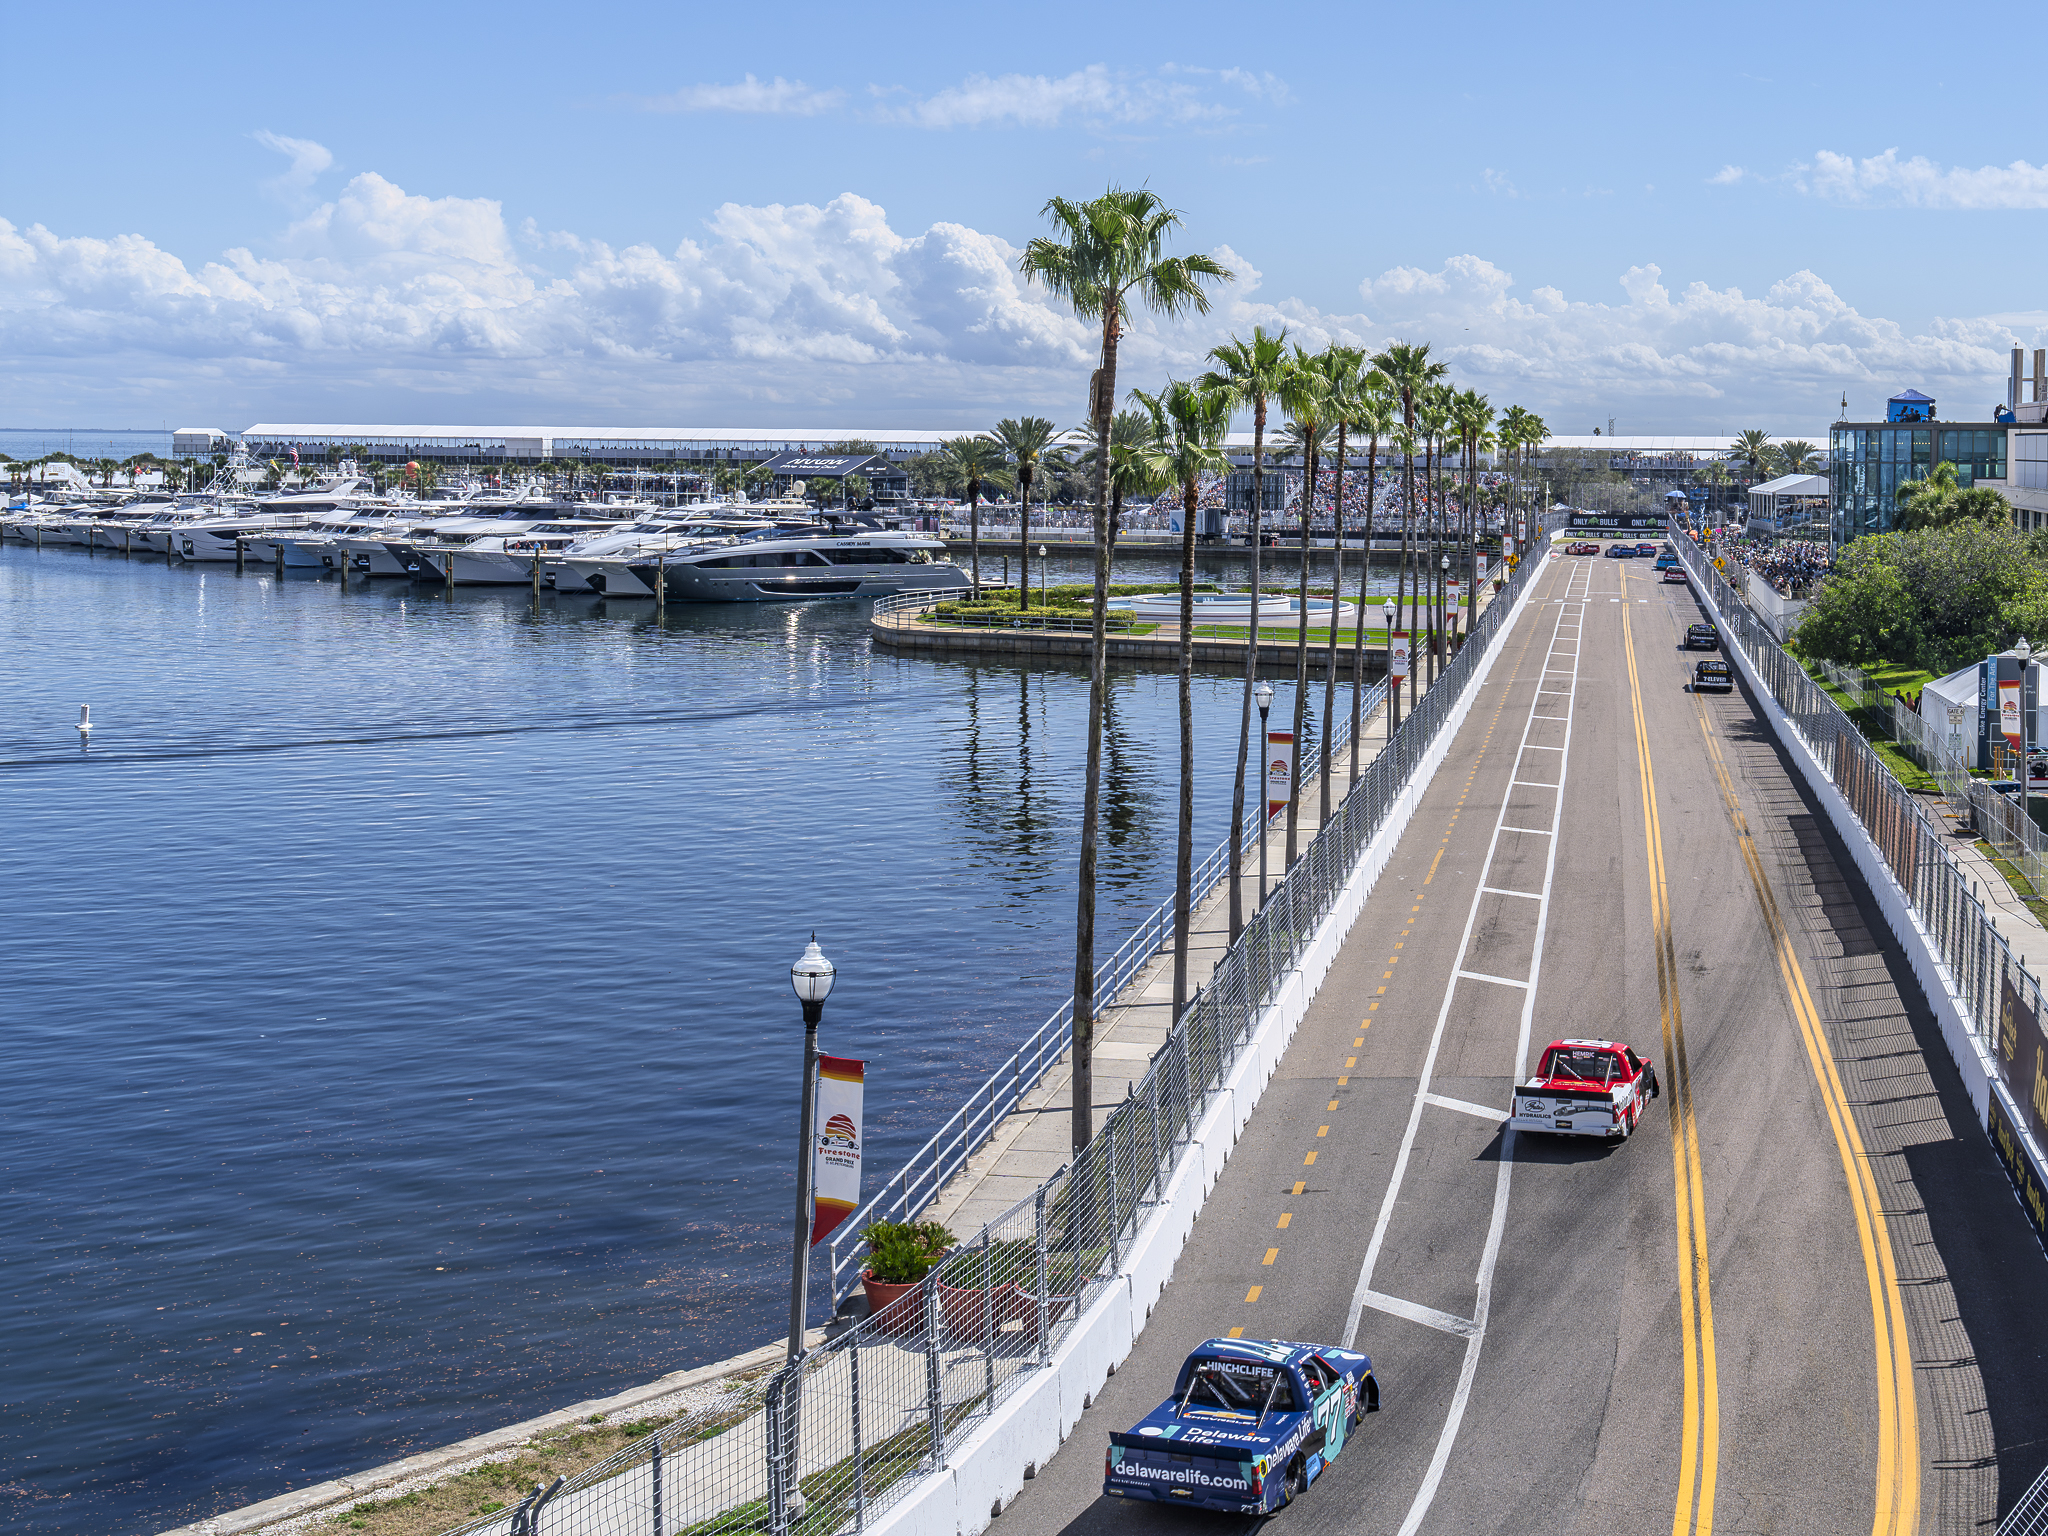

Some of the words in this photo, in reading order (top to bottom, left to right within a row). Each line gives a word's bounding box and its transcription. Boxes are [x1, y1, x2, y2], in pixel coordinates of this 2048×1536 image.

[1573, 517, 1588, 526] ONLY
[1599, 518, 1619, 526] BULLS
[1631, 518, 1647, 527] ONLY
[1657, 519, 1670, 527] BULL
[1979, 677, 1987, 697] Center
[1979, 697, 1987, 719] Energy
[1572, 1050, 1595, 1058] HEMRIC
[818, 1147, 860, 1160] Firestone
[1206, 1360, 1274, 1378] HINCHCLIFFE
[1180, 1434, 1215, 1445] Life
[1186, 1427, 1271, 1443] Delaware
[1265, 1432, 1300, 1473] Delaware
[1298, 1416, 1311, 1443] Life
[1115, 1461, 1248, 1491] delawarelife.com
